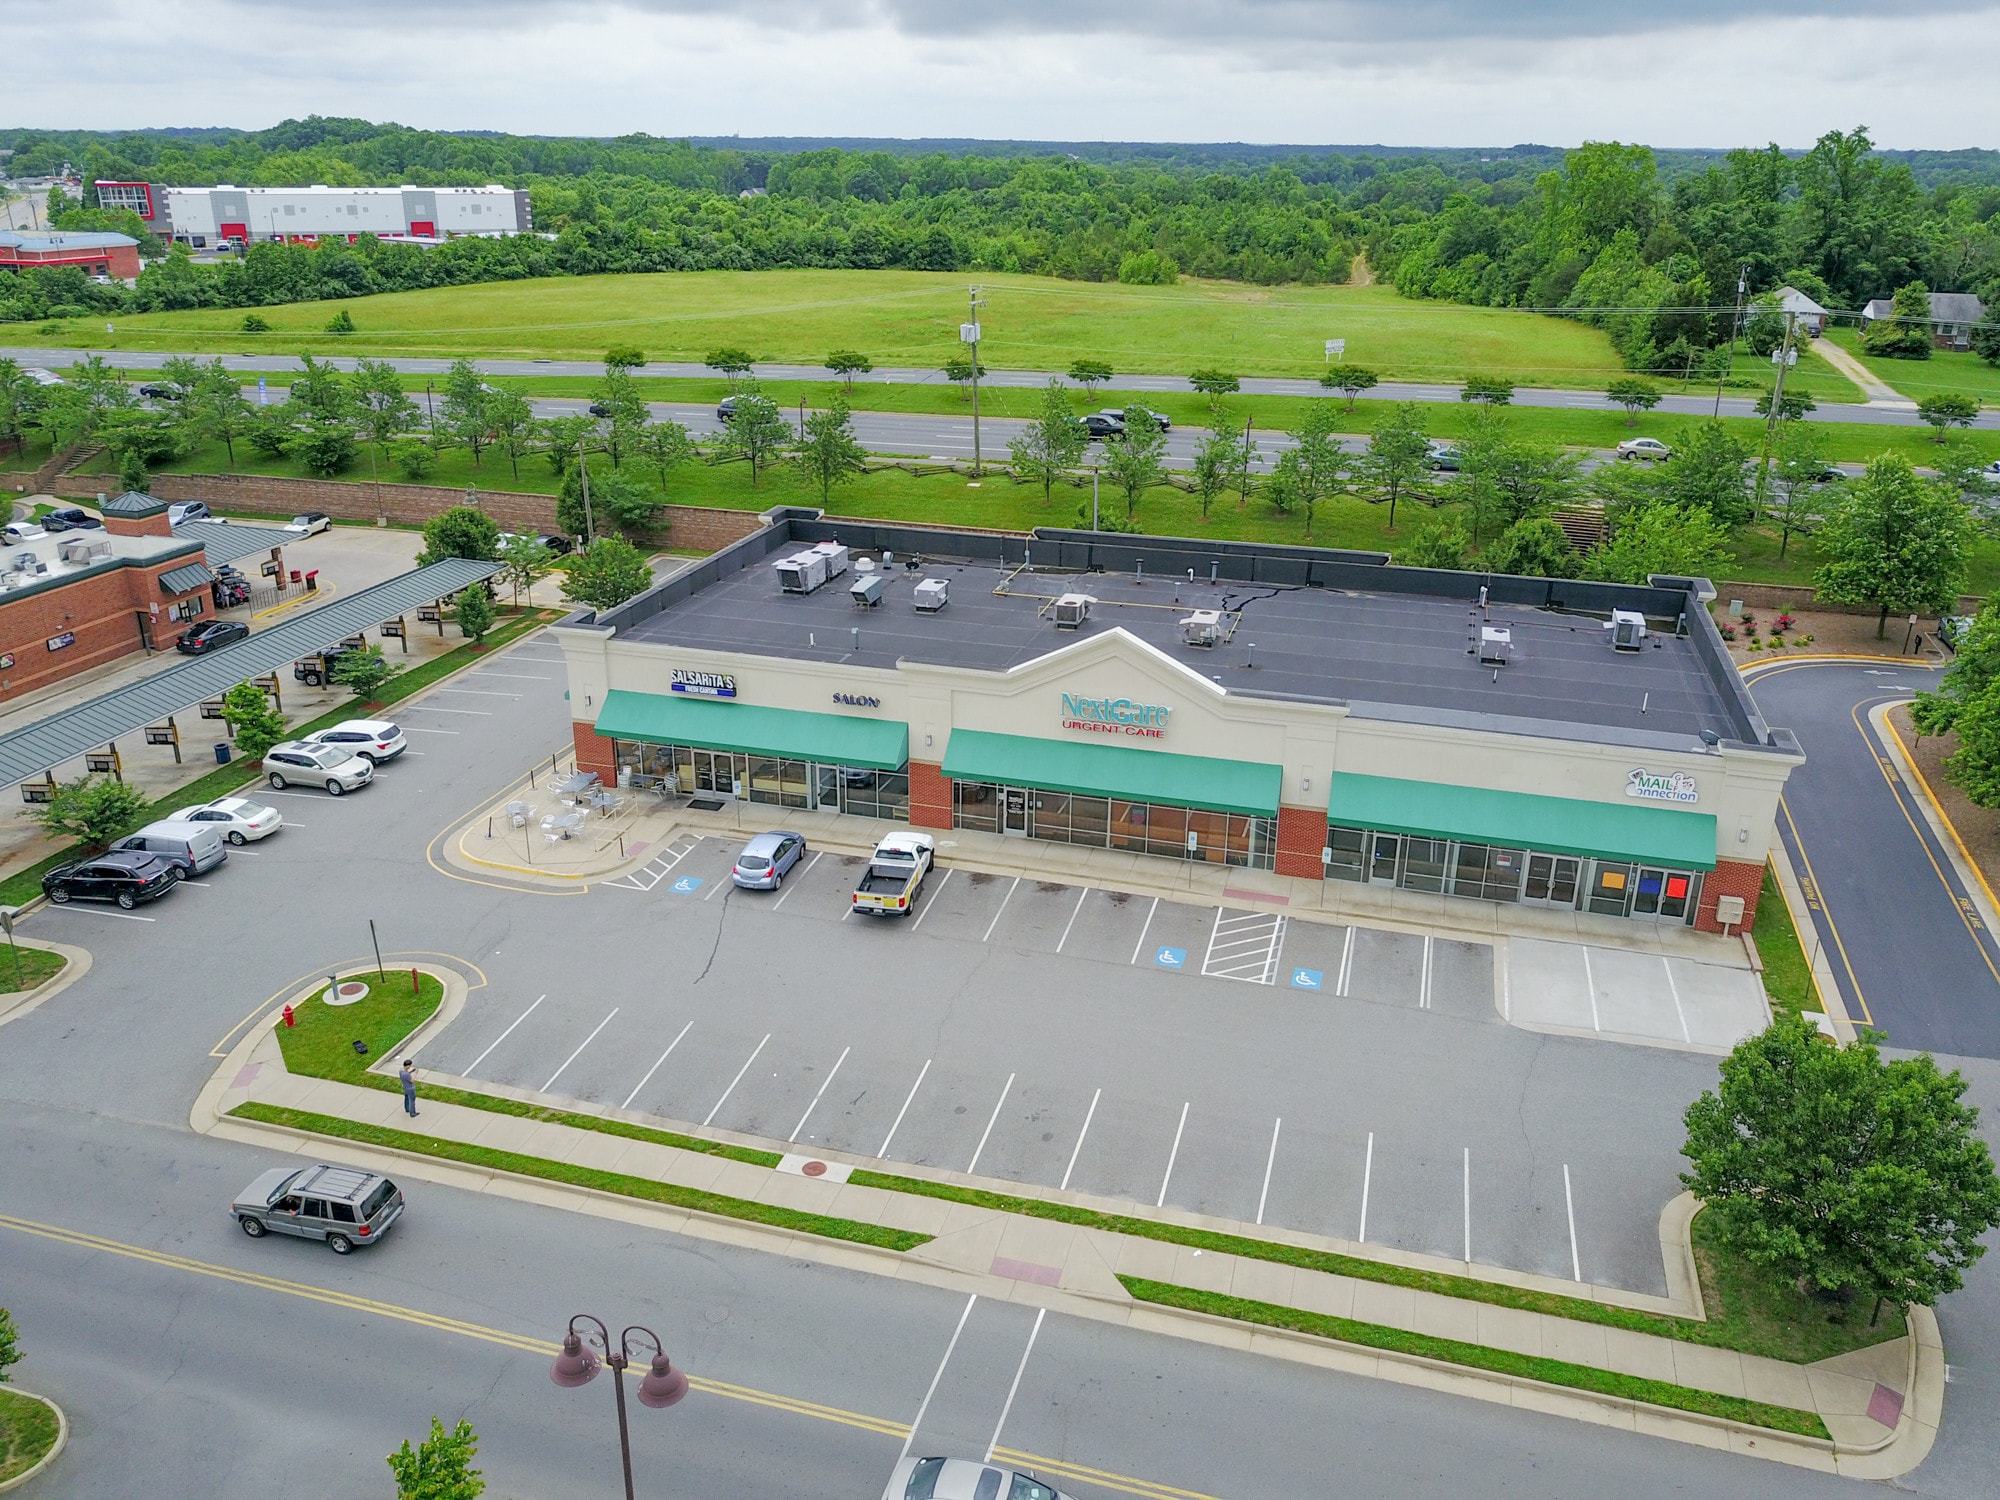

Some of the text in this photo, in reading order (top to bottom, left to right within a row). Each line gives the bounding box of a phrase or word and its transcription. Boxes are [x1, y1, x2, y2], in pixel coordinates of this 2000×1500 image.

[832, 692, 881, 708] SALON
[1060, 692, 1171, 727] NextCare
[1062, 720, 1166, 739] URGENT CARE
[1638, 777, 1673, 791] MAIL
